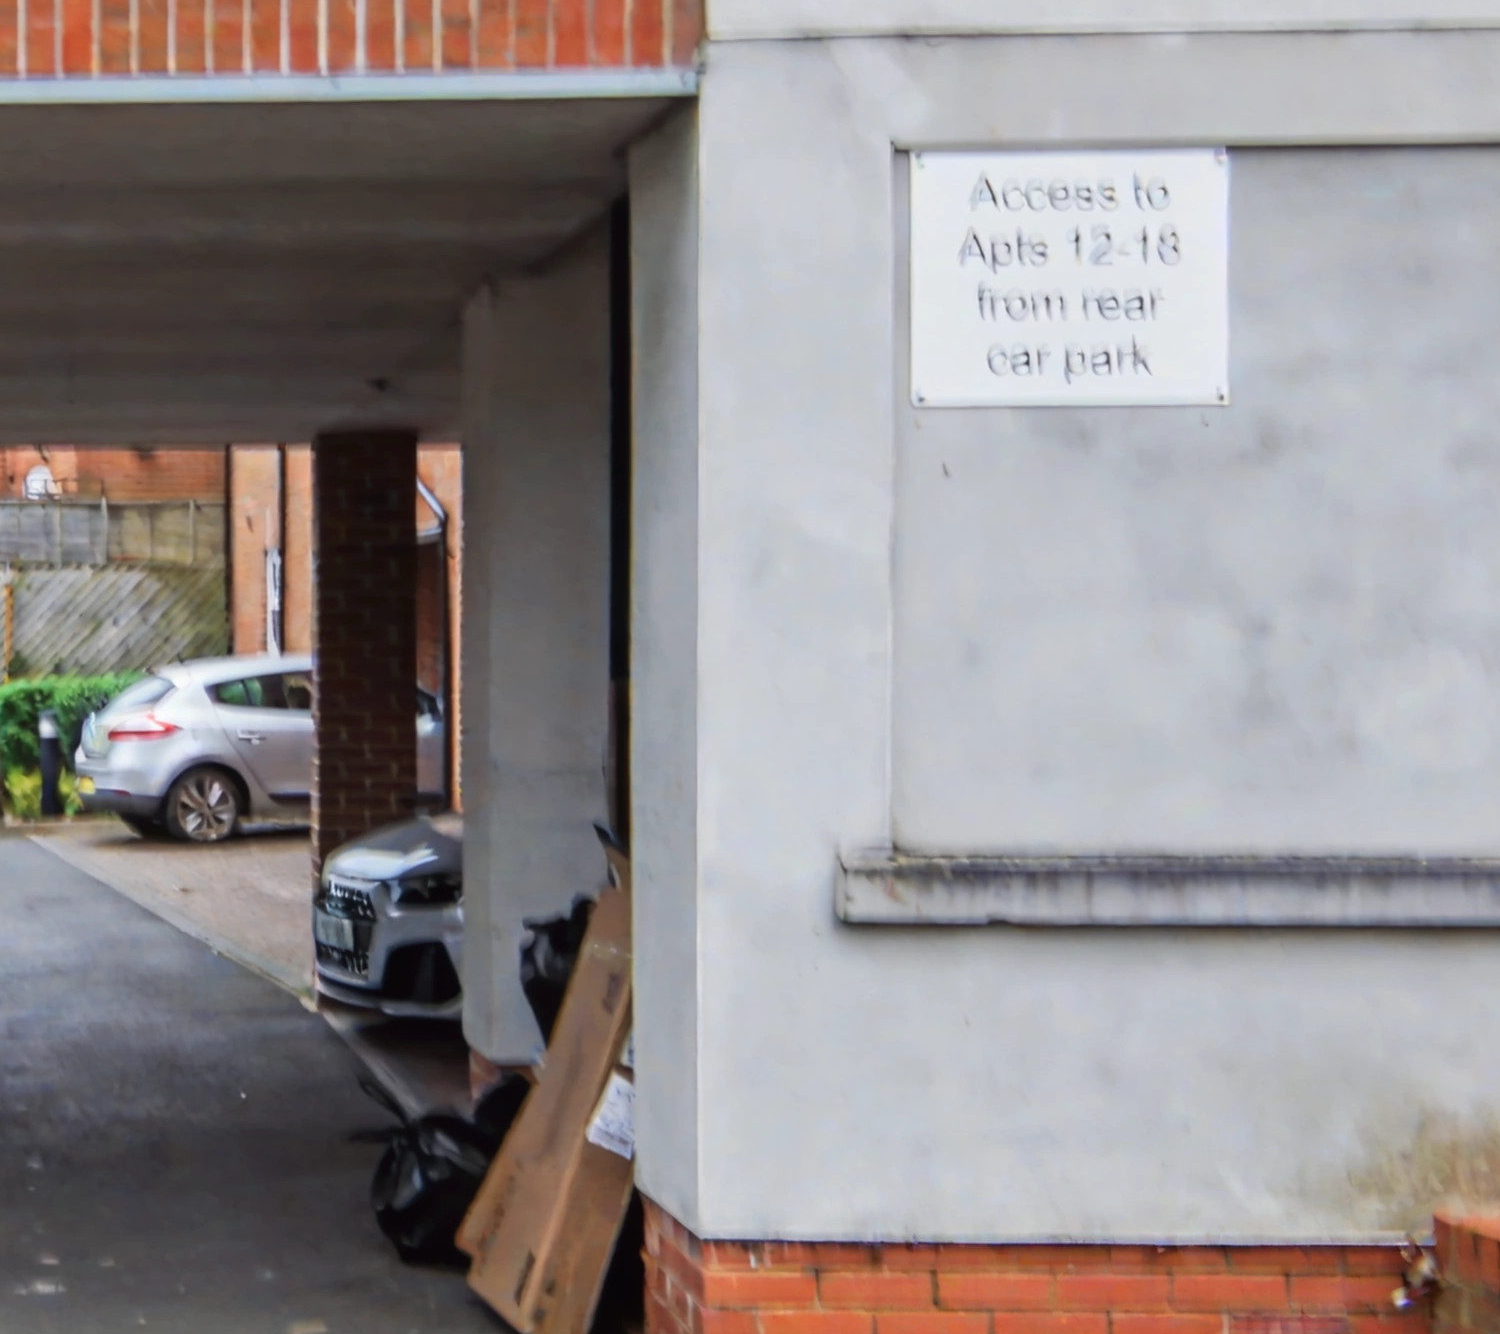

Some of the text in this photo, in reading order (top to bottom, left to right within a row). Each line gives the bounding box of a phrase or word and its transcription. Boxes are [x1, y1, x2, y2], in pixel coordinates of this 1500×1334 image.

[968, 170, 1171, 212] Access to
[959, 223, 1181, 274] Apts 12-18
[976, 282, 1165, 322] from rear
[986, 335, 1153, 384] car park
